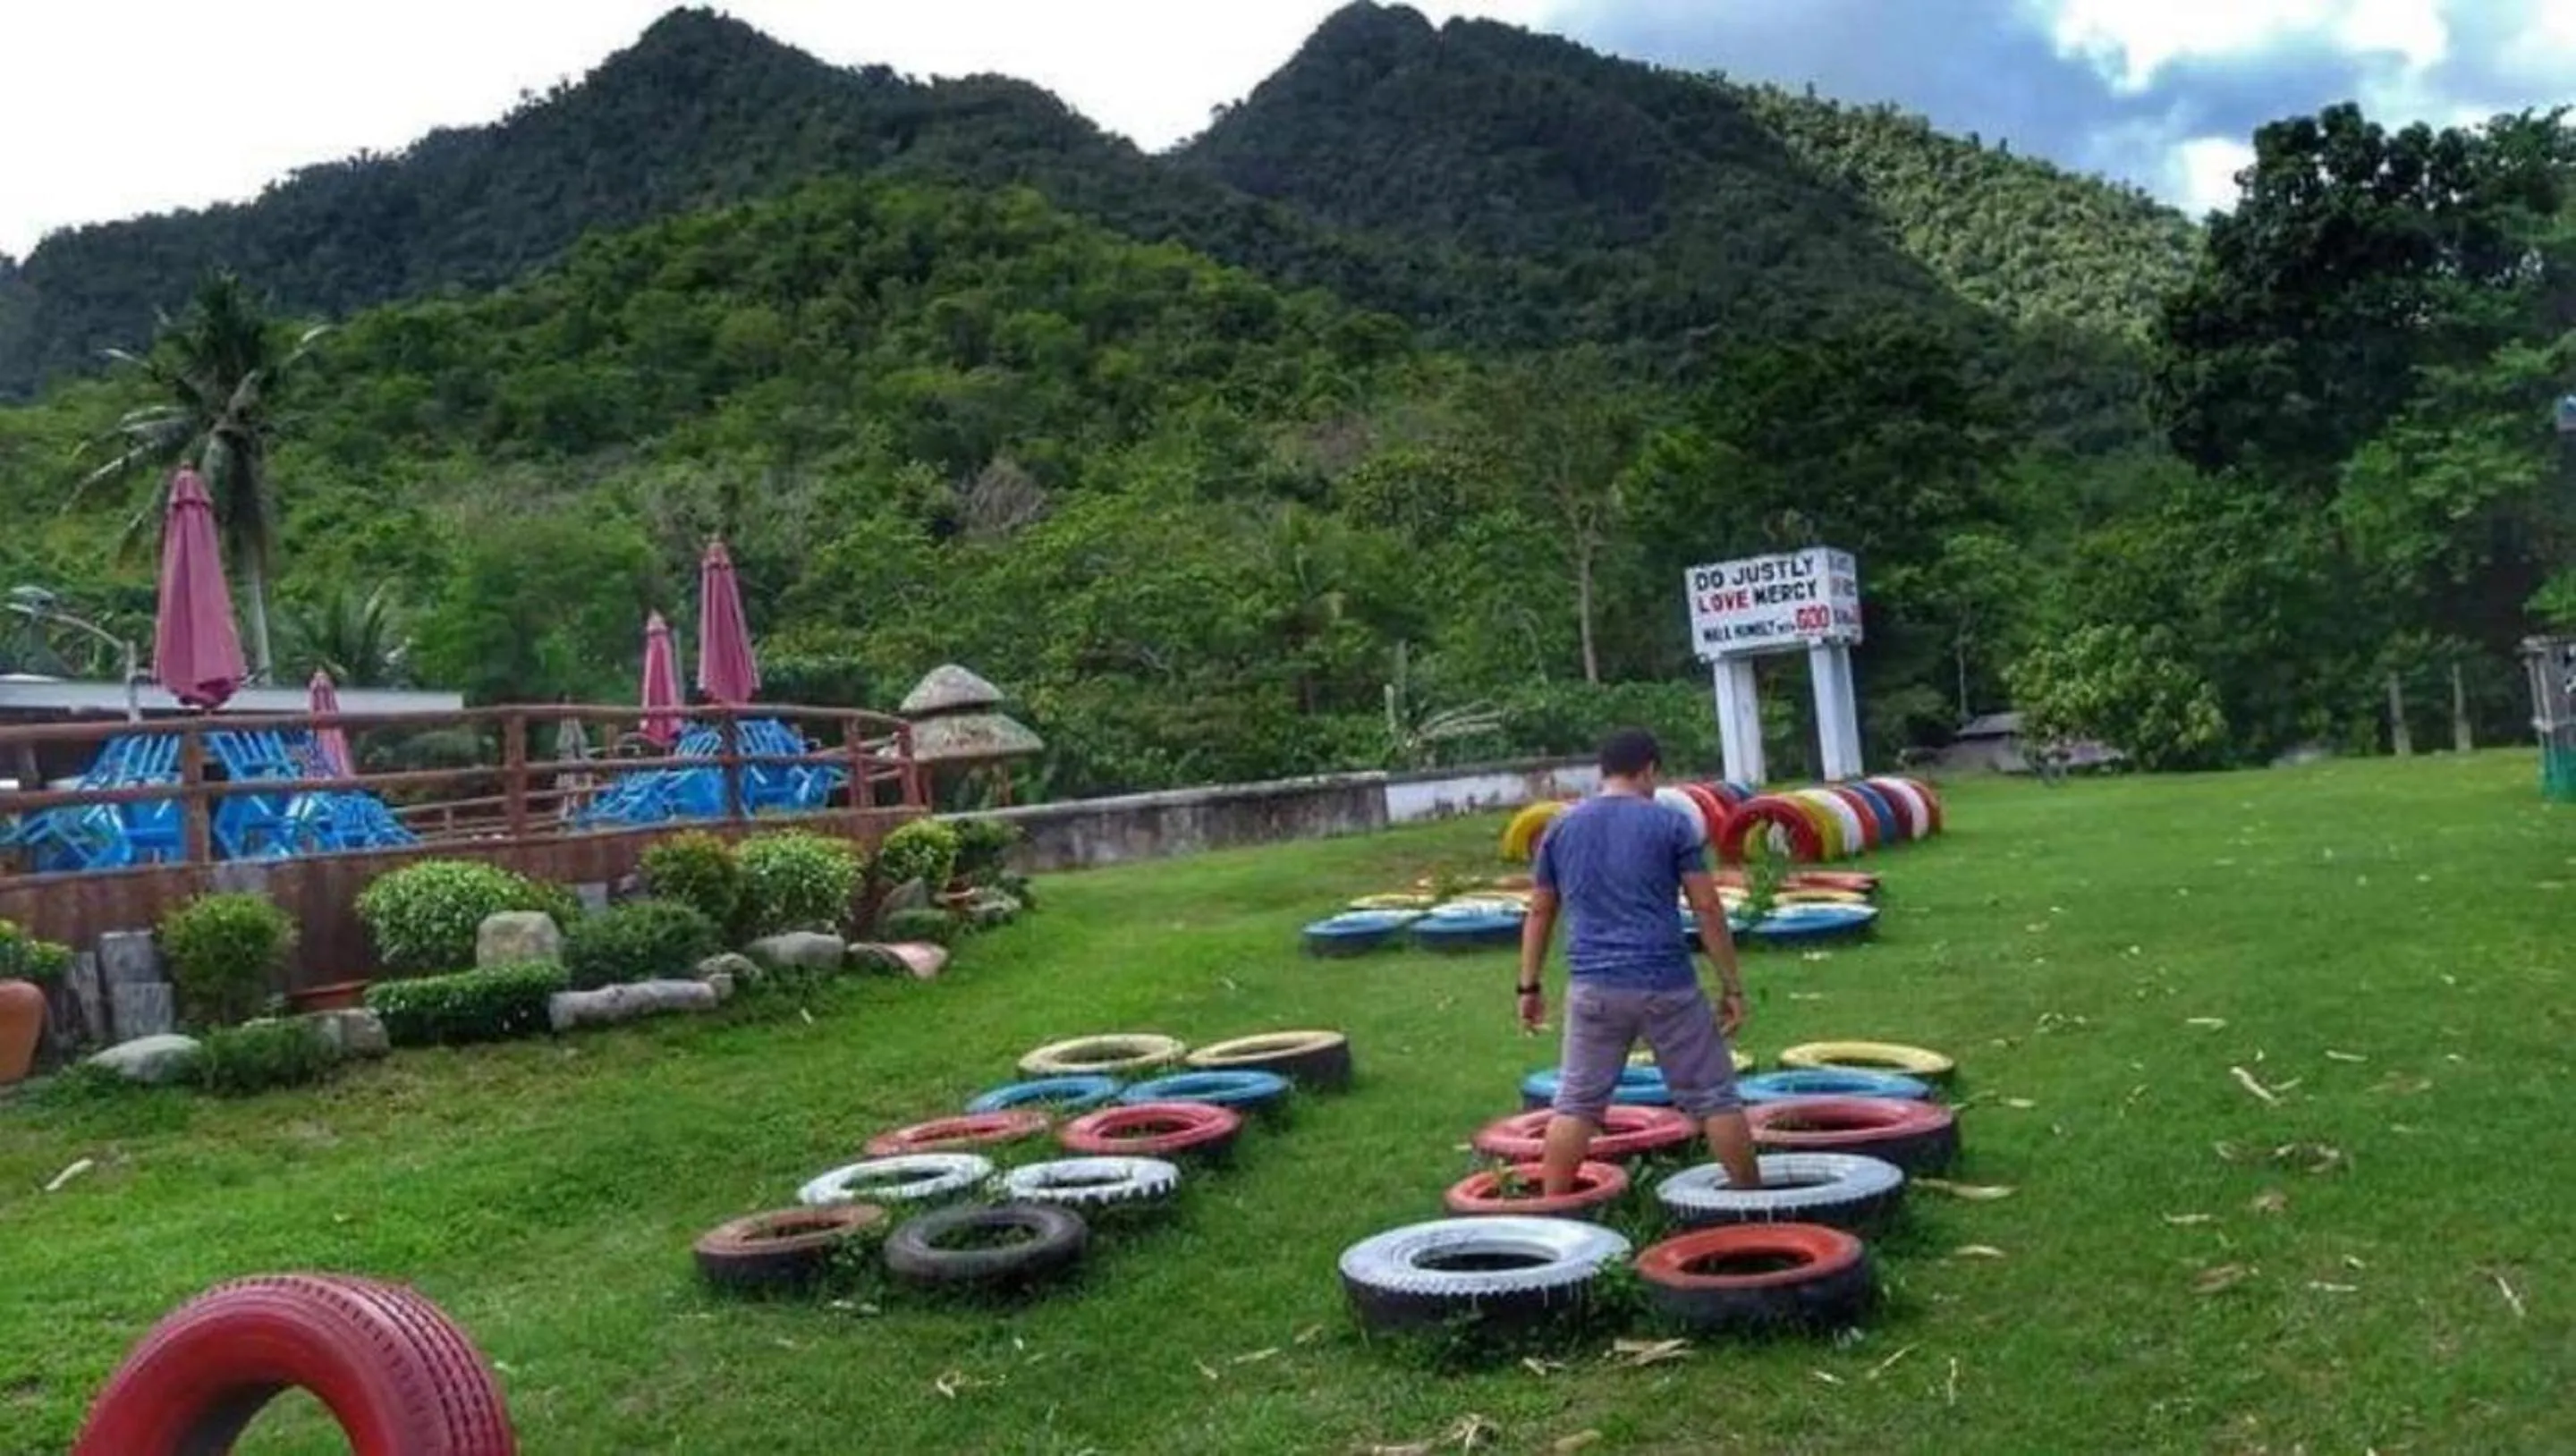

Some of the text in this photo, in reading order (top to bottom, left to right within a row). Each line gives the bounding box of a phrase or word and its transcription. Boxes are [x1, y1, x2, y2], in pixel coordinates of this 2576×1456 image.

[1695, 571, 1724, 590] DO
[1732, 556, 1814, 586] JUSTLY
[1698, 589, 1749, 613] LOVE
[1754, 580, 1817, 605] MERCY
[1796, 605, 1829, 630] GOD
